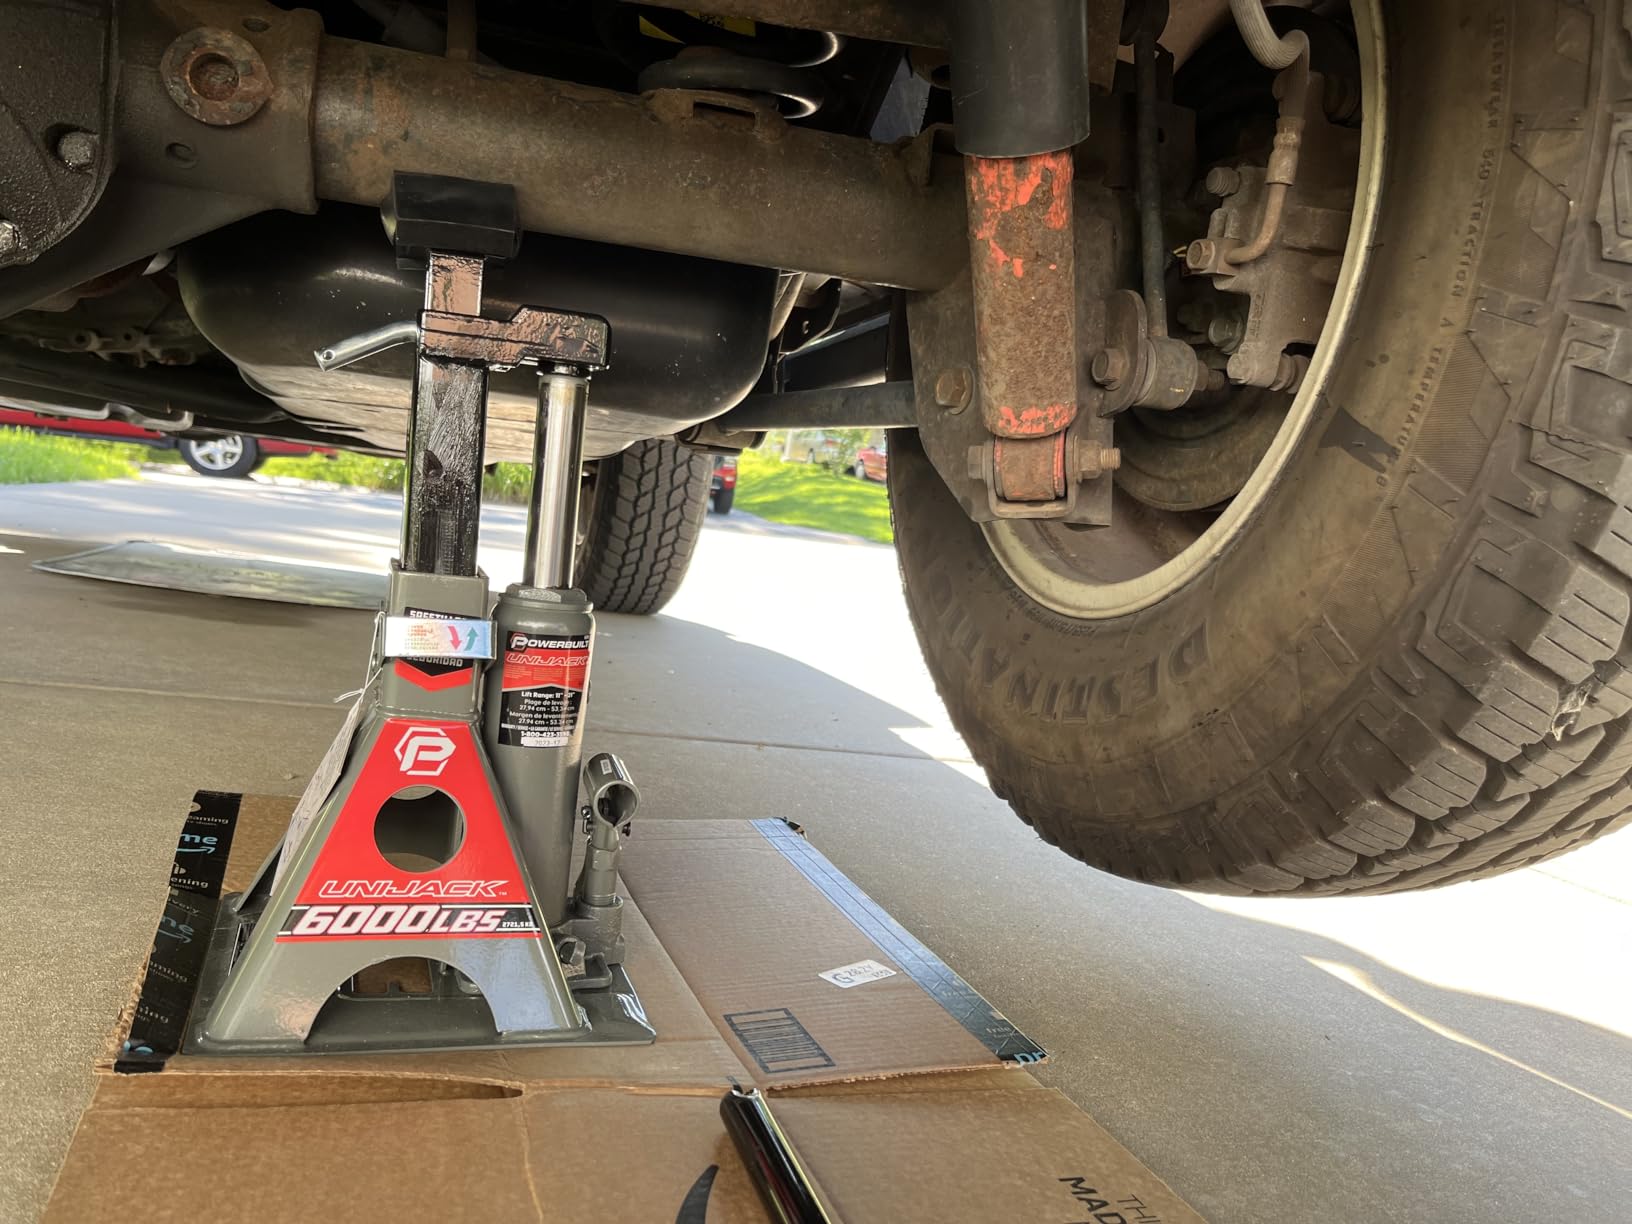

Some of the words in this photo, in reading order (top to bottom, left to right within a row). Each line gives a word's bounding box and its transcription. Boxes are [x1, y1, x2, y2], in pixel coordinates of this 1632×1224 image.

[1450, 199, 1485, 298] TRACTION
[511, 636, 589, 649] POWERBUILT
[533, 692, 555, 700] Range:
